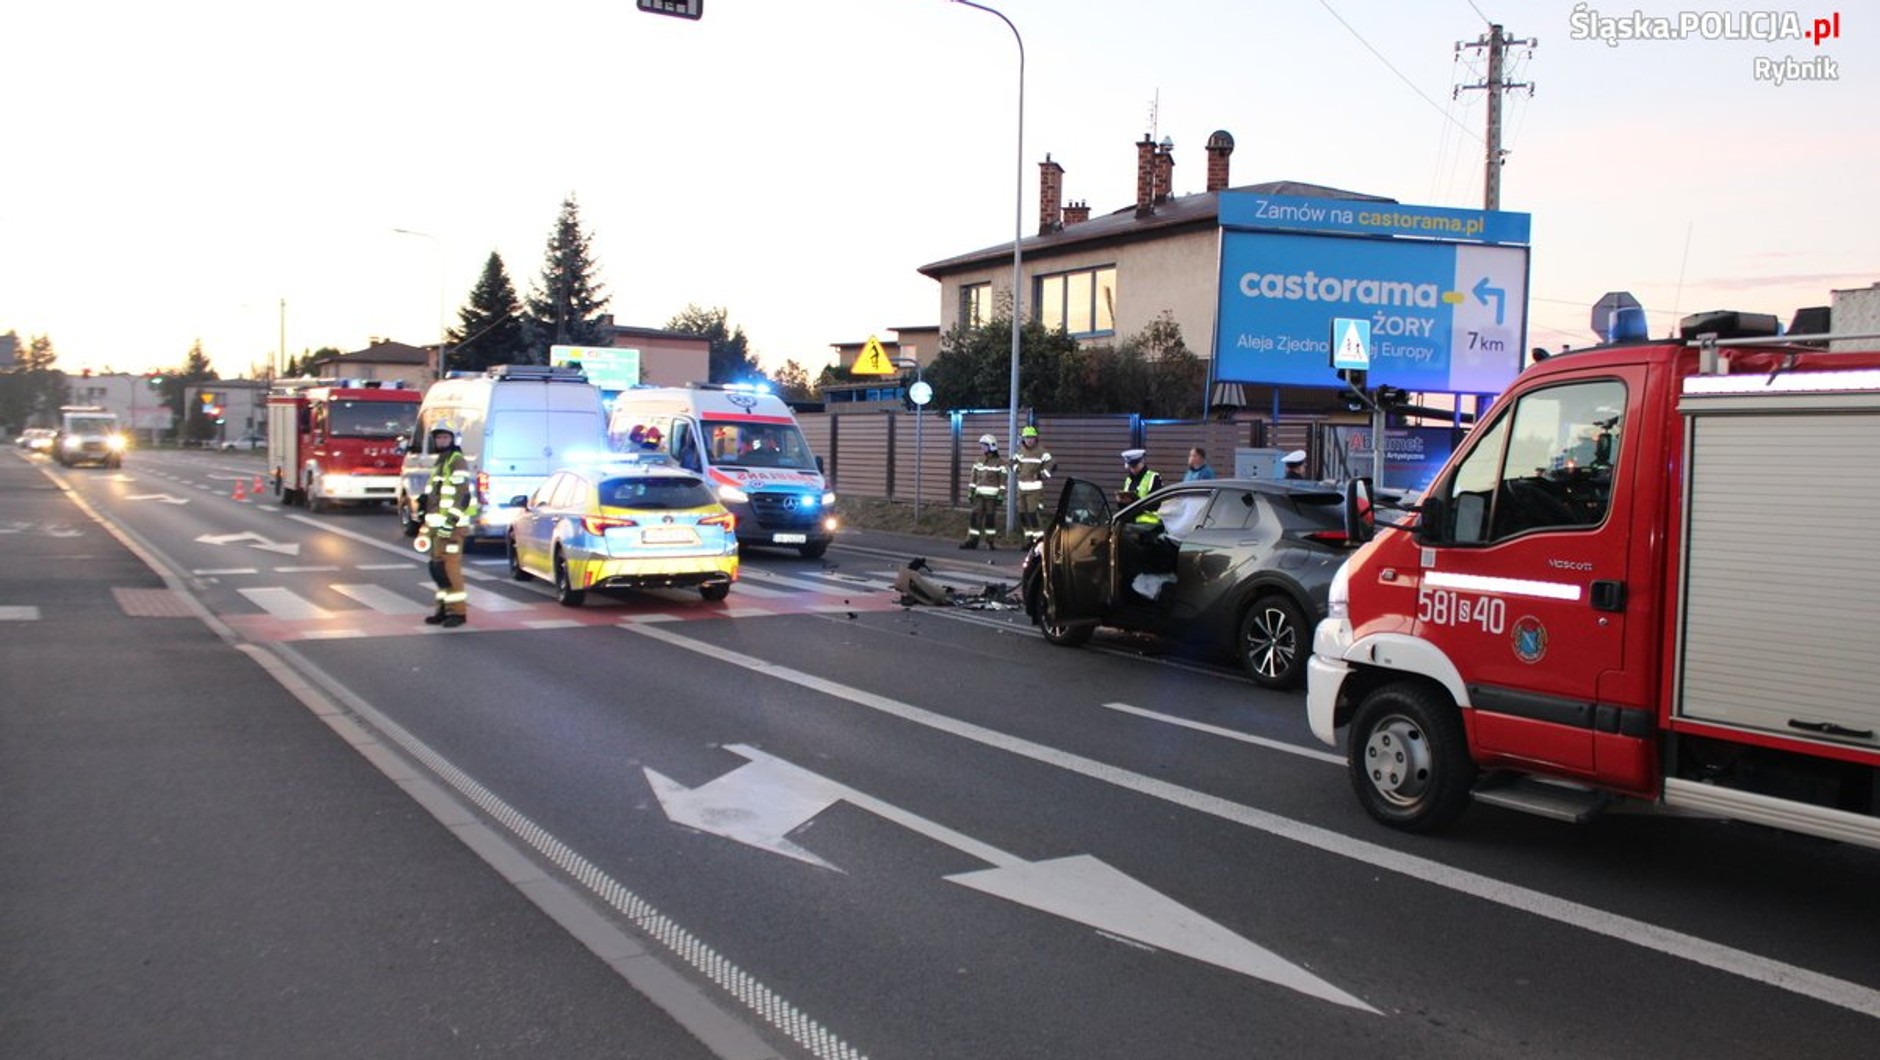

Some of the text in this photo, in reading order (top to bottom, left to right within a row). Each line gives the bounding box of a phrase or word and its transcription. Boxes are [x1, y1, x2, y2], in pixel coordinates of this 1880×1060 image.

[1255, 199, 1486, 234] Zamów na castorama.pl
[1239, 271, 1438, 308] castorama
[1371, 310, 1435, 337] ŻORY
[1237, 333, 1273, 352] Aleja
[1382, 342, 1434, 361] Europy
[1481, 336, 1504, 352] km
